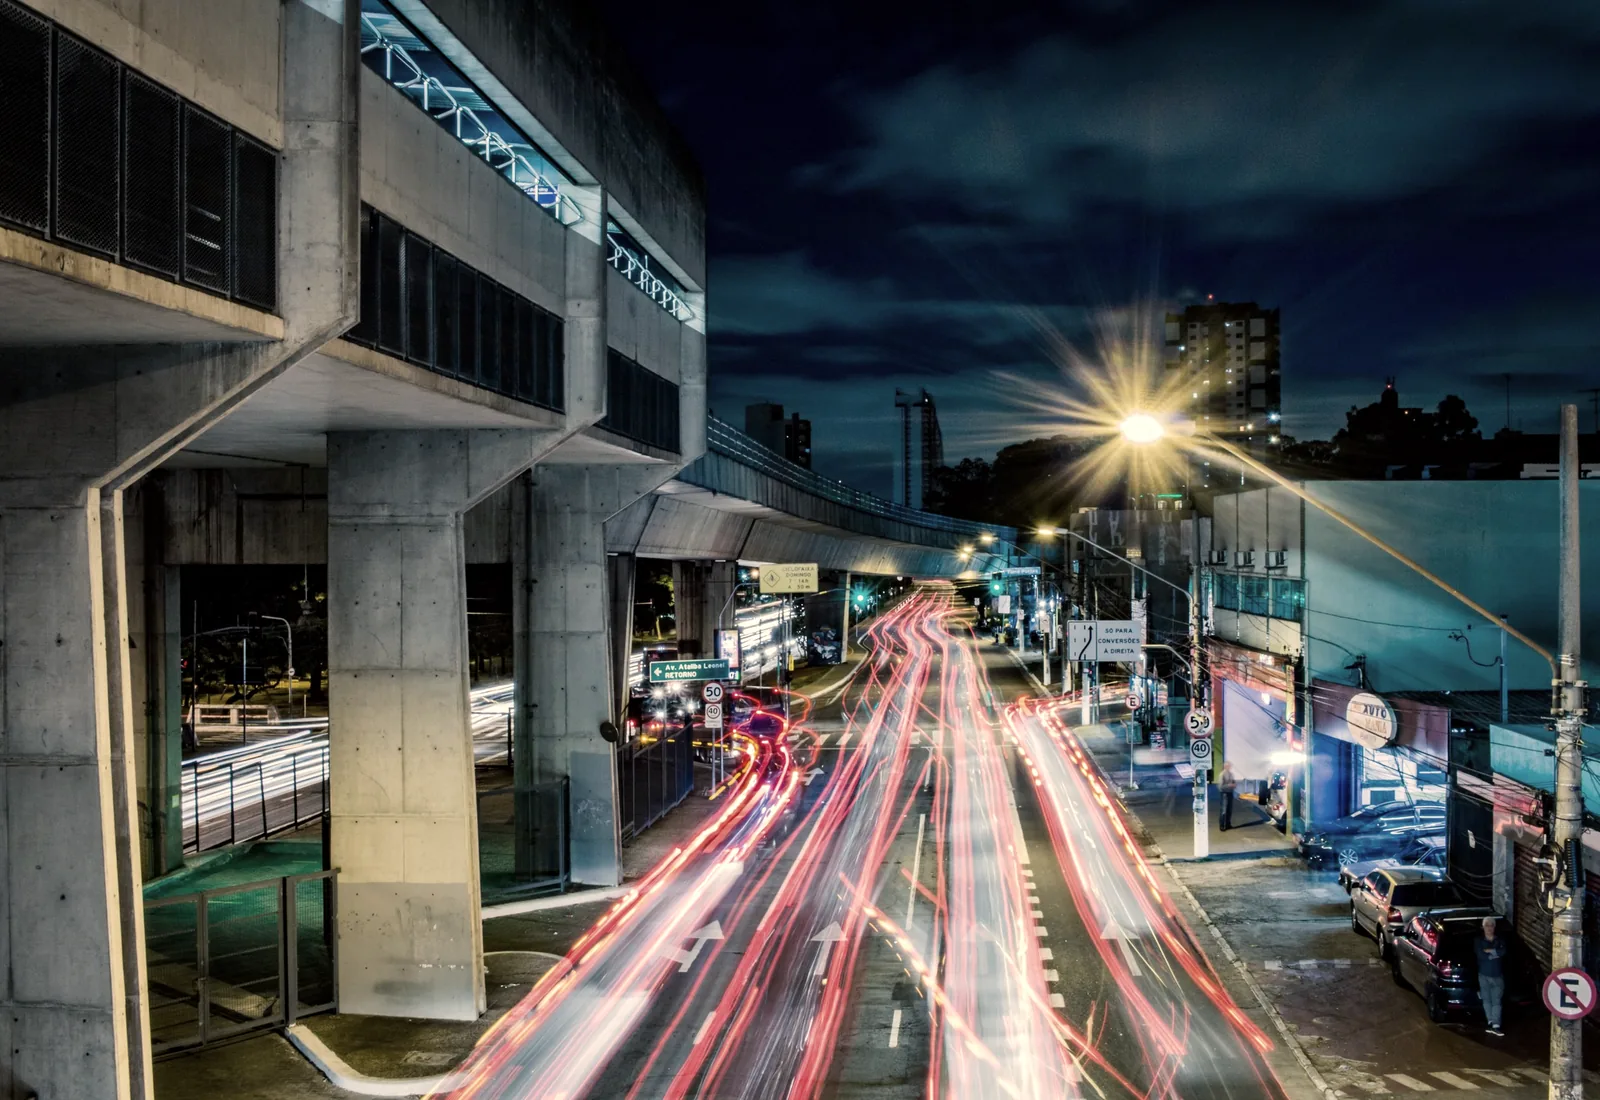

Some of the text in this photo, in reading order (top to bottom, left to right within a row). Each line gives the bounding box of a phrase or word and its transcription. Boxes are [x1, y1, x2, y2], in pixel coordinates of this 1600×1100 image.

[678, 662, 702, 670] Ataliba
[665, 671, 697, 679] RETORNO
[706, 687, 721, 697] 50
[1129, 697, 1136, 707] E
[708, 707, 718, 715] 40
[1363, 704, 1387, 718] AUTO
[1194, 743, 1207, 752] 40
[1560, 978, 1579, 1008] E
